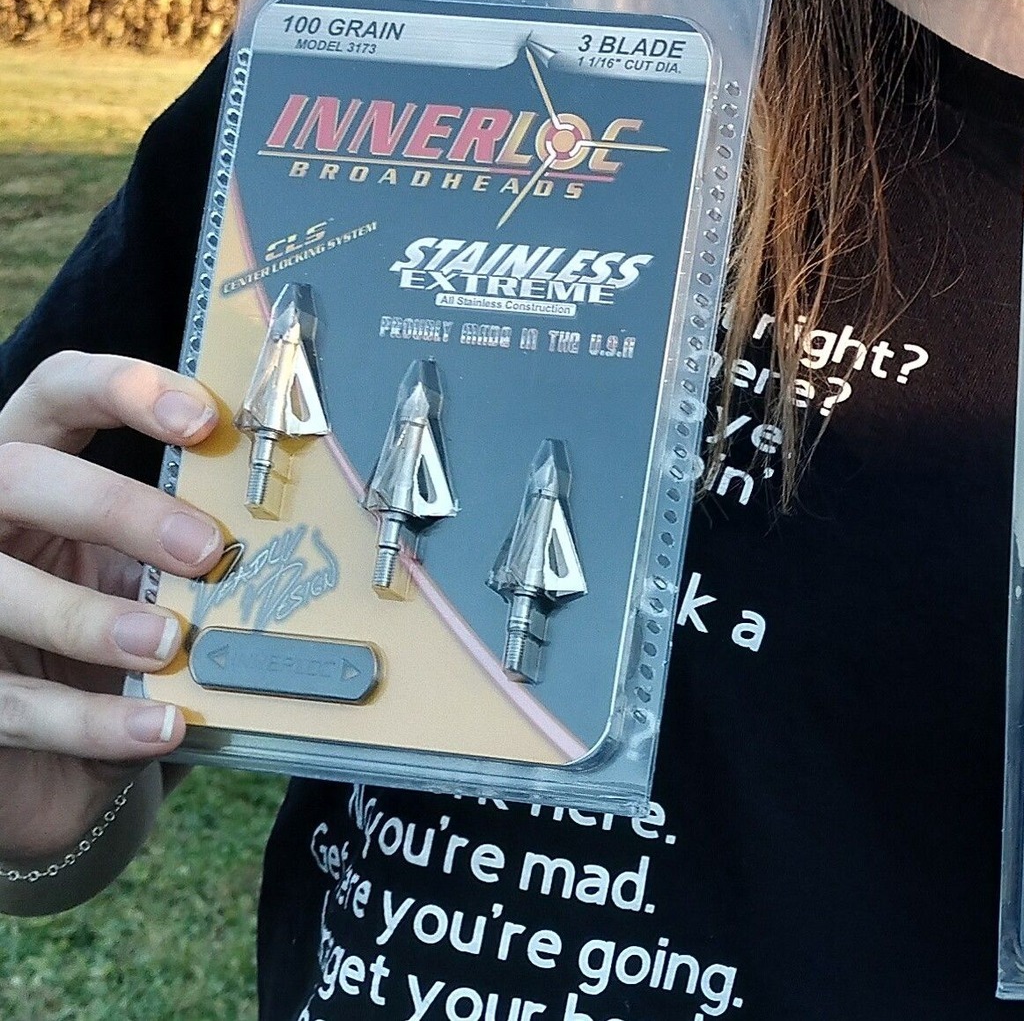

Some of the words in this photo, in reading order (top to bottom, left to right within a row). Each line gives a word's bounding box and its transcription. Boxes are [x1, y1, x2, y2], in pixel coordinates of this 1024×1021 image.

[283, 15, 321, 35] 100
[327, 17, 405, 40] GRAIN
[296, 38, 343, 53] MODEL
[347, 42, 377, 55] 3173
[578, 34, 592, 54] 3
[598, 35, 687, 60] BLADE
[624, 60, 653, 72] CUT
[655, 62, 683, 75] DIA.
[266, 94, 644, 173] INNERLOC
[289, 161, 585, 200] BROADHEADS
[272, 242, 327, 273] LOCKING
[327, 220, 378, 249] SYSTEM
[389, 236, 655, 290] STAINLESS
[399, 270, 617, 306] EXTREME
[440, 296, 454, 305] All
[456, 297, 502, 310] Stainless
[505, 300, 572, 315] Construction
[362, 815, 506, 885] you're
[518, 855, 656, 915] mad.
[375, 889, 563, 970] you're
[577, 936, 744, 1017] going.
